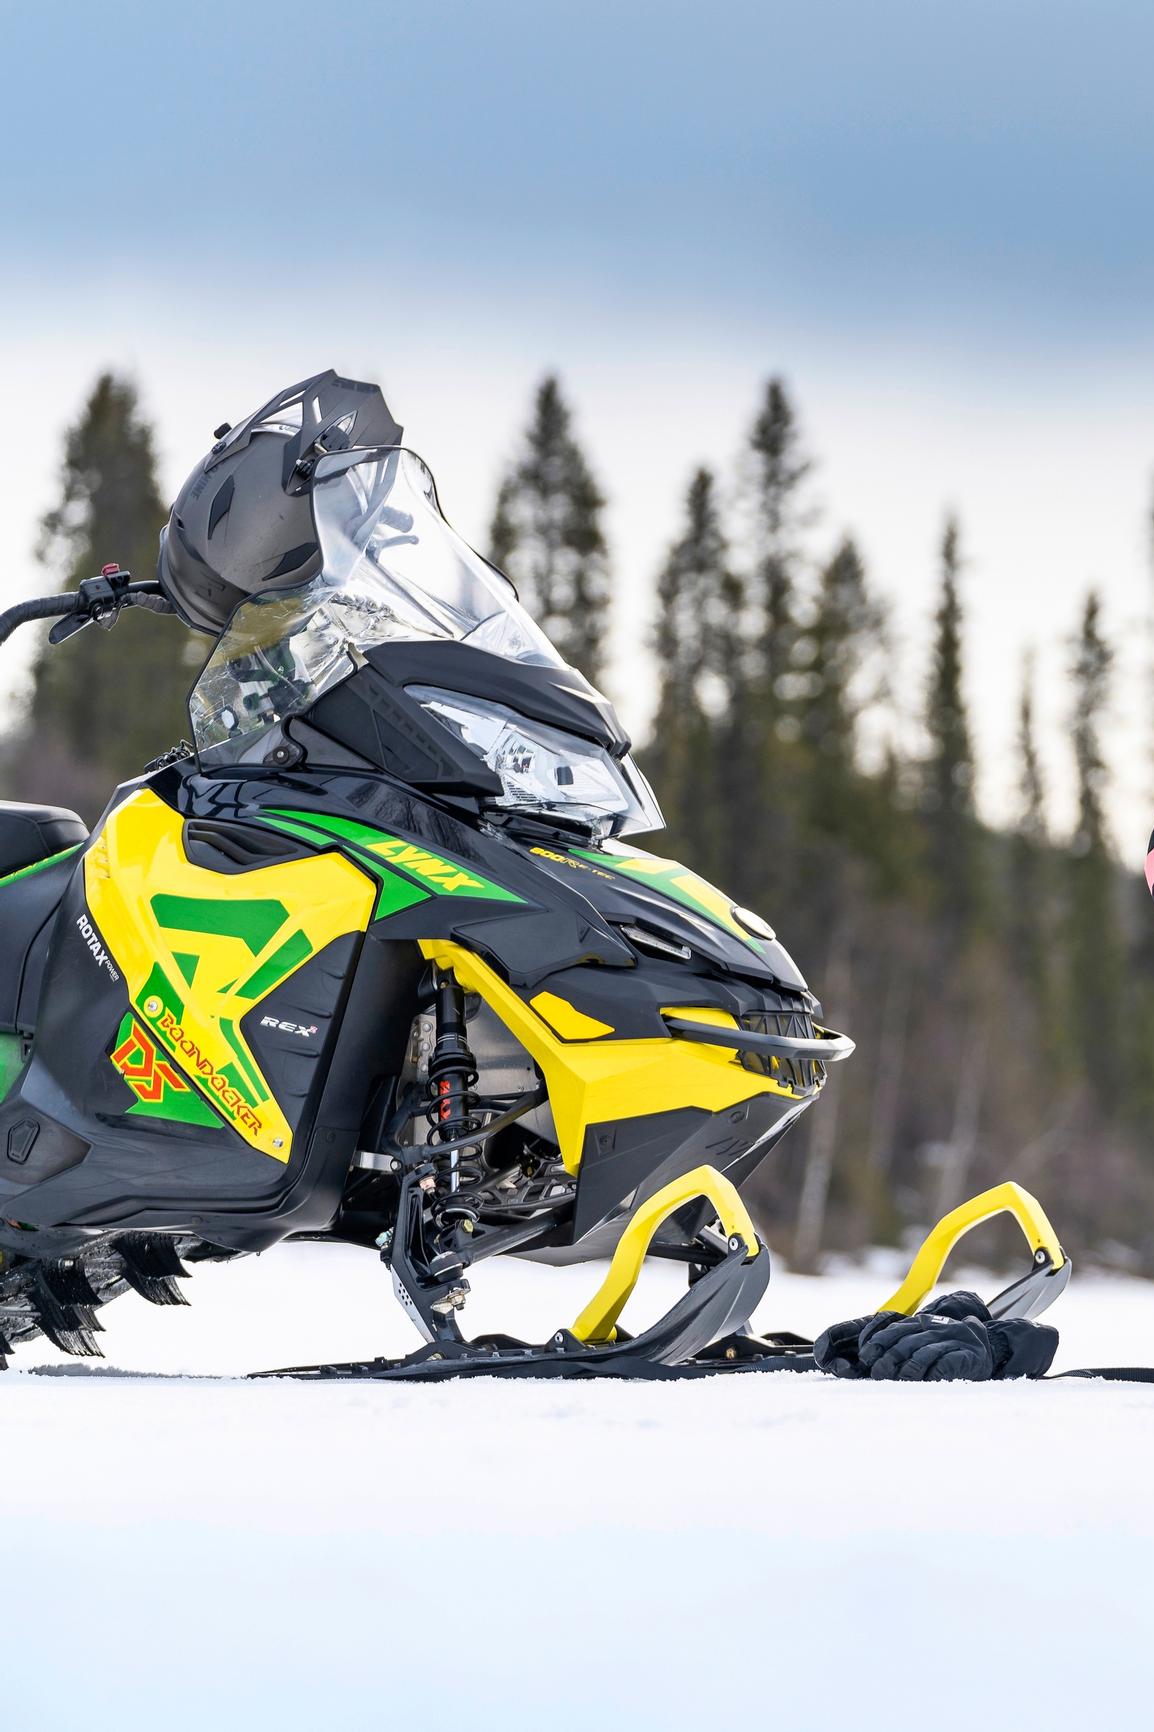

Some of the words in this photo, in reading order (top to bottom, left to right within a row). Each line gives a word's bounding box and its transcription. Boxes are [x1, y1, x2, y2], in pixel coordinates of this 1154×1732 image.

[365, 840, 486, 892] LYNX
[76, 913, 108, 967] ROTAX
[105, 959, 119, 981] POWER
[160, 1013, 262, 1137] BOONDOCKER
